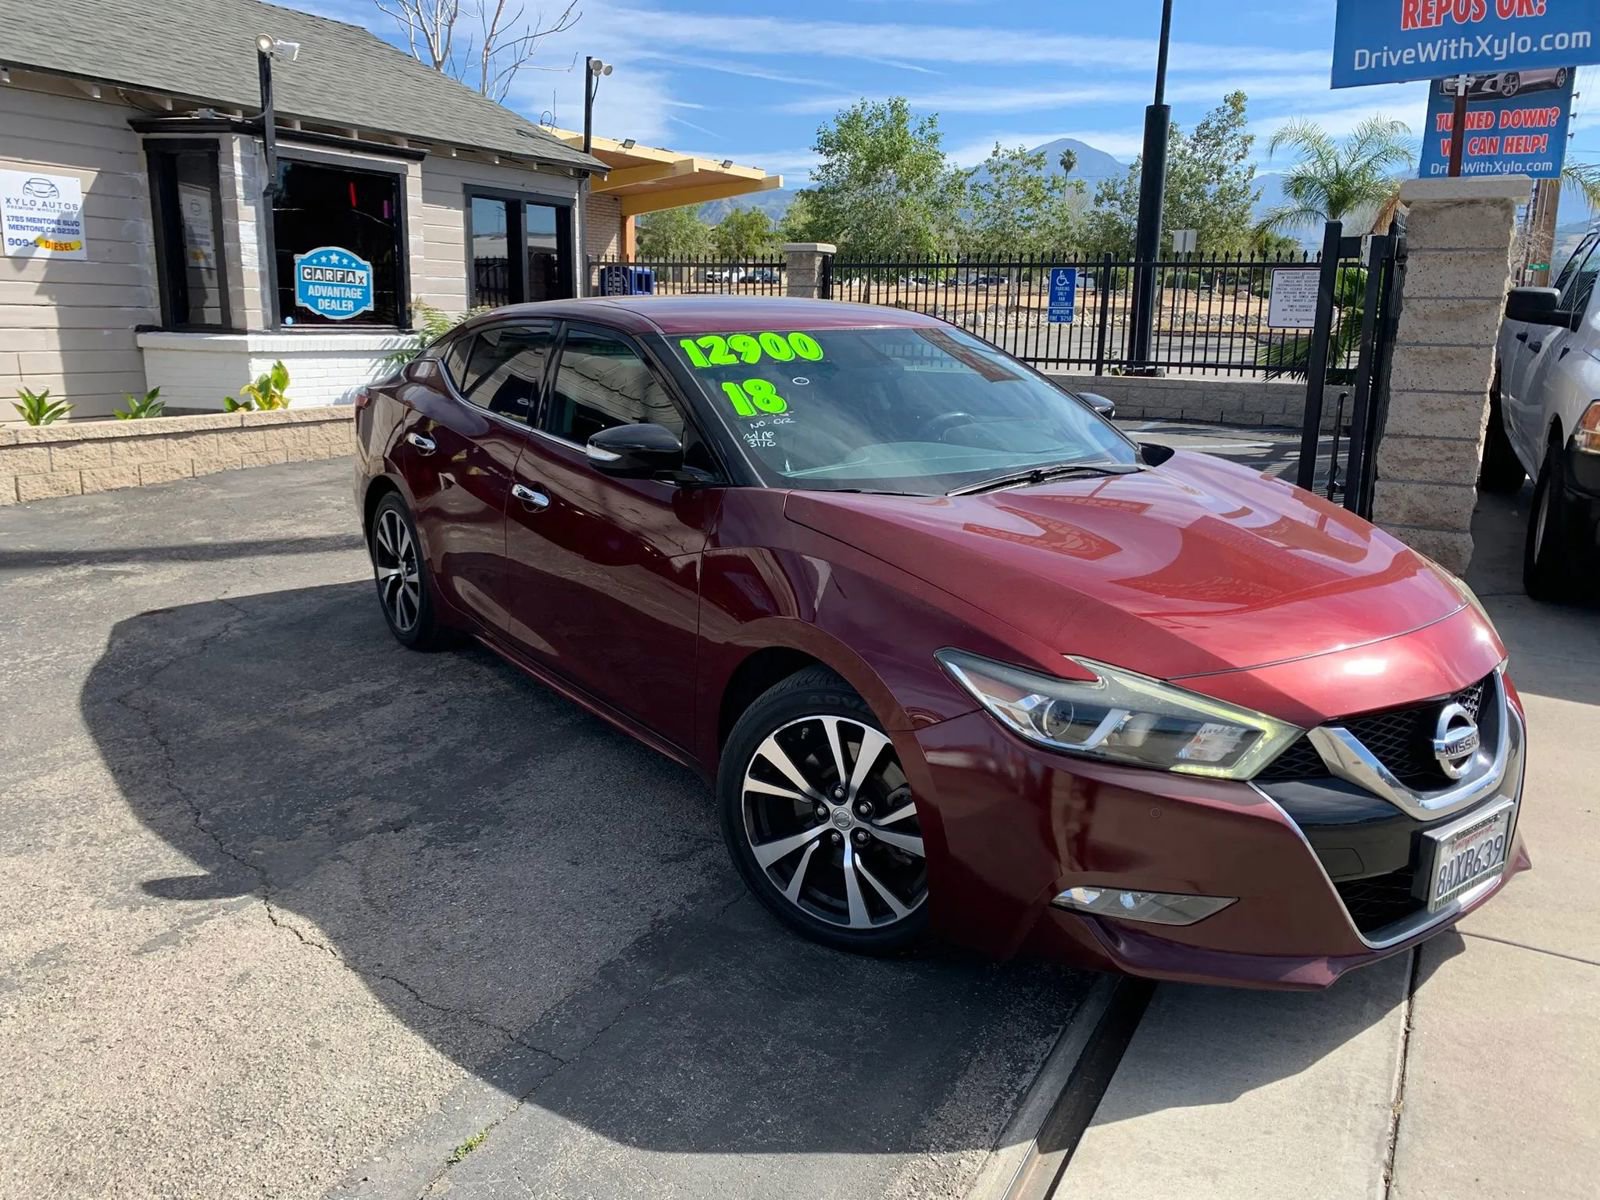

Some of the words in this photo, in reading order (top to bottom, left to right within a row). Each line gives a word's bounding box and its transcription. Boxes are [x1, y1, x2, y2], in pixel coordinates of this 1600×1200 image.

[1354, 30, 1592, 71] DriveWithXylo.com
[1436, 111, 1495, 132] TUNED
[1499, 106, 1560, 129] DOWN?
[1468, 136, 1500, 156] CAN
[1503, 133, 1549, 155] HELP!
[1430, 161, 1553, 175] DriWithXylo.com
[5, 197, 37, 207] XYLO
[42, 200, 79, 211] AUTOS
[8, 224, 45, 233] MENTONE
[25, 216, 61, 226] MENTONE
[62, 219, 80, 227] BLVD
[45, 240, 74, 251] DIESEL
[303, 268, 364, 285] CARFAX
[307, 284, 363, 299] ADVANTAGE
[318, 298, 354, 311] DEALER
[680, 332, 824, 368] 12900
[721, 378, 788, 416] 18
[1445, 736, 1478, 755] NISSA
